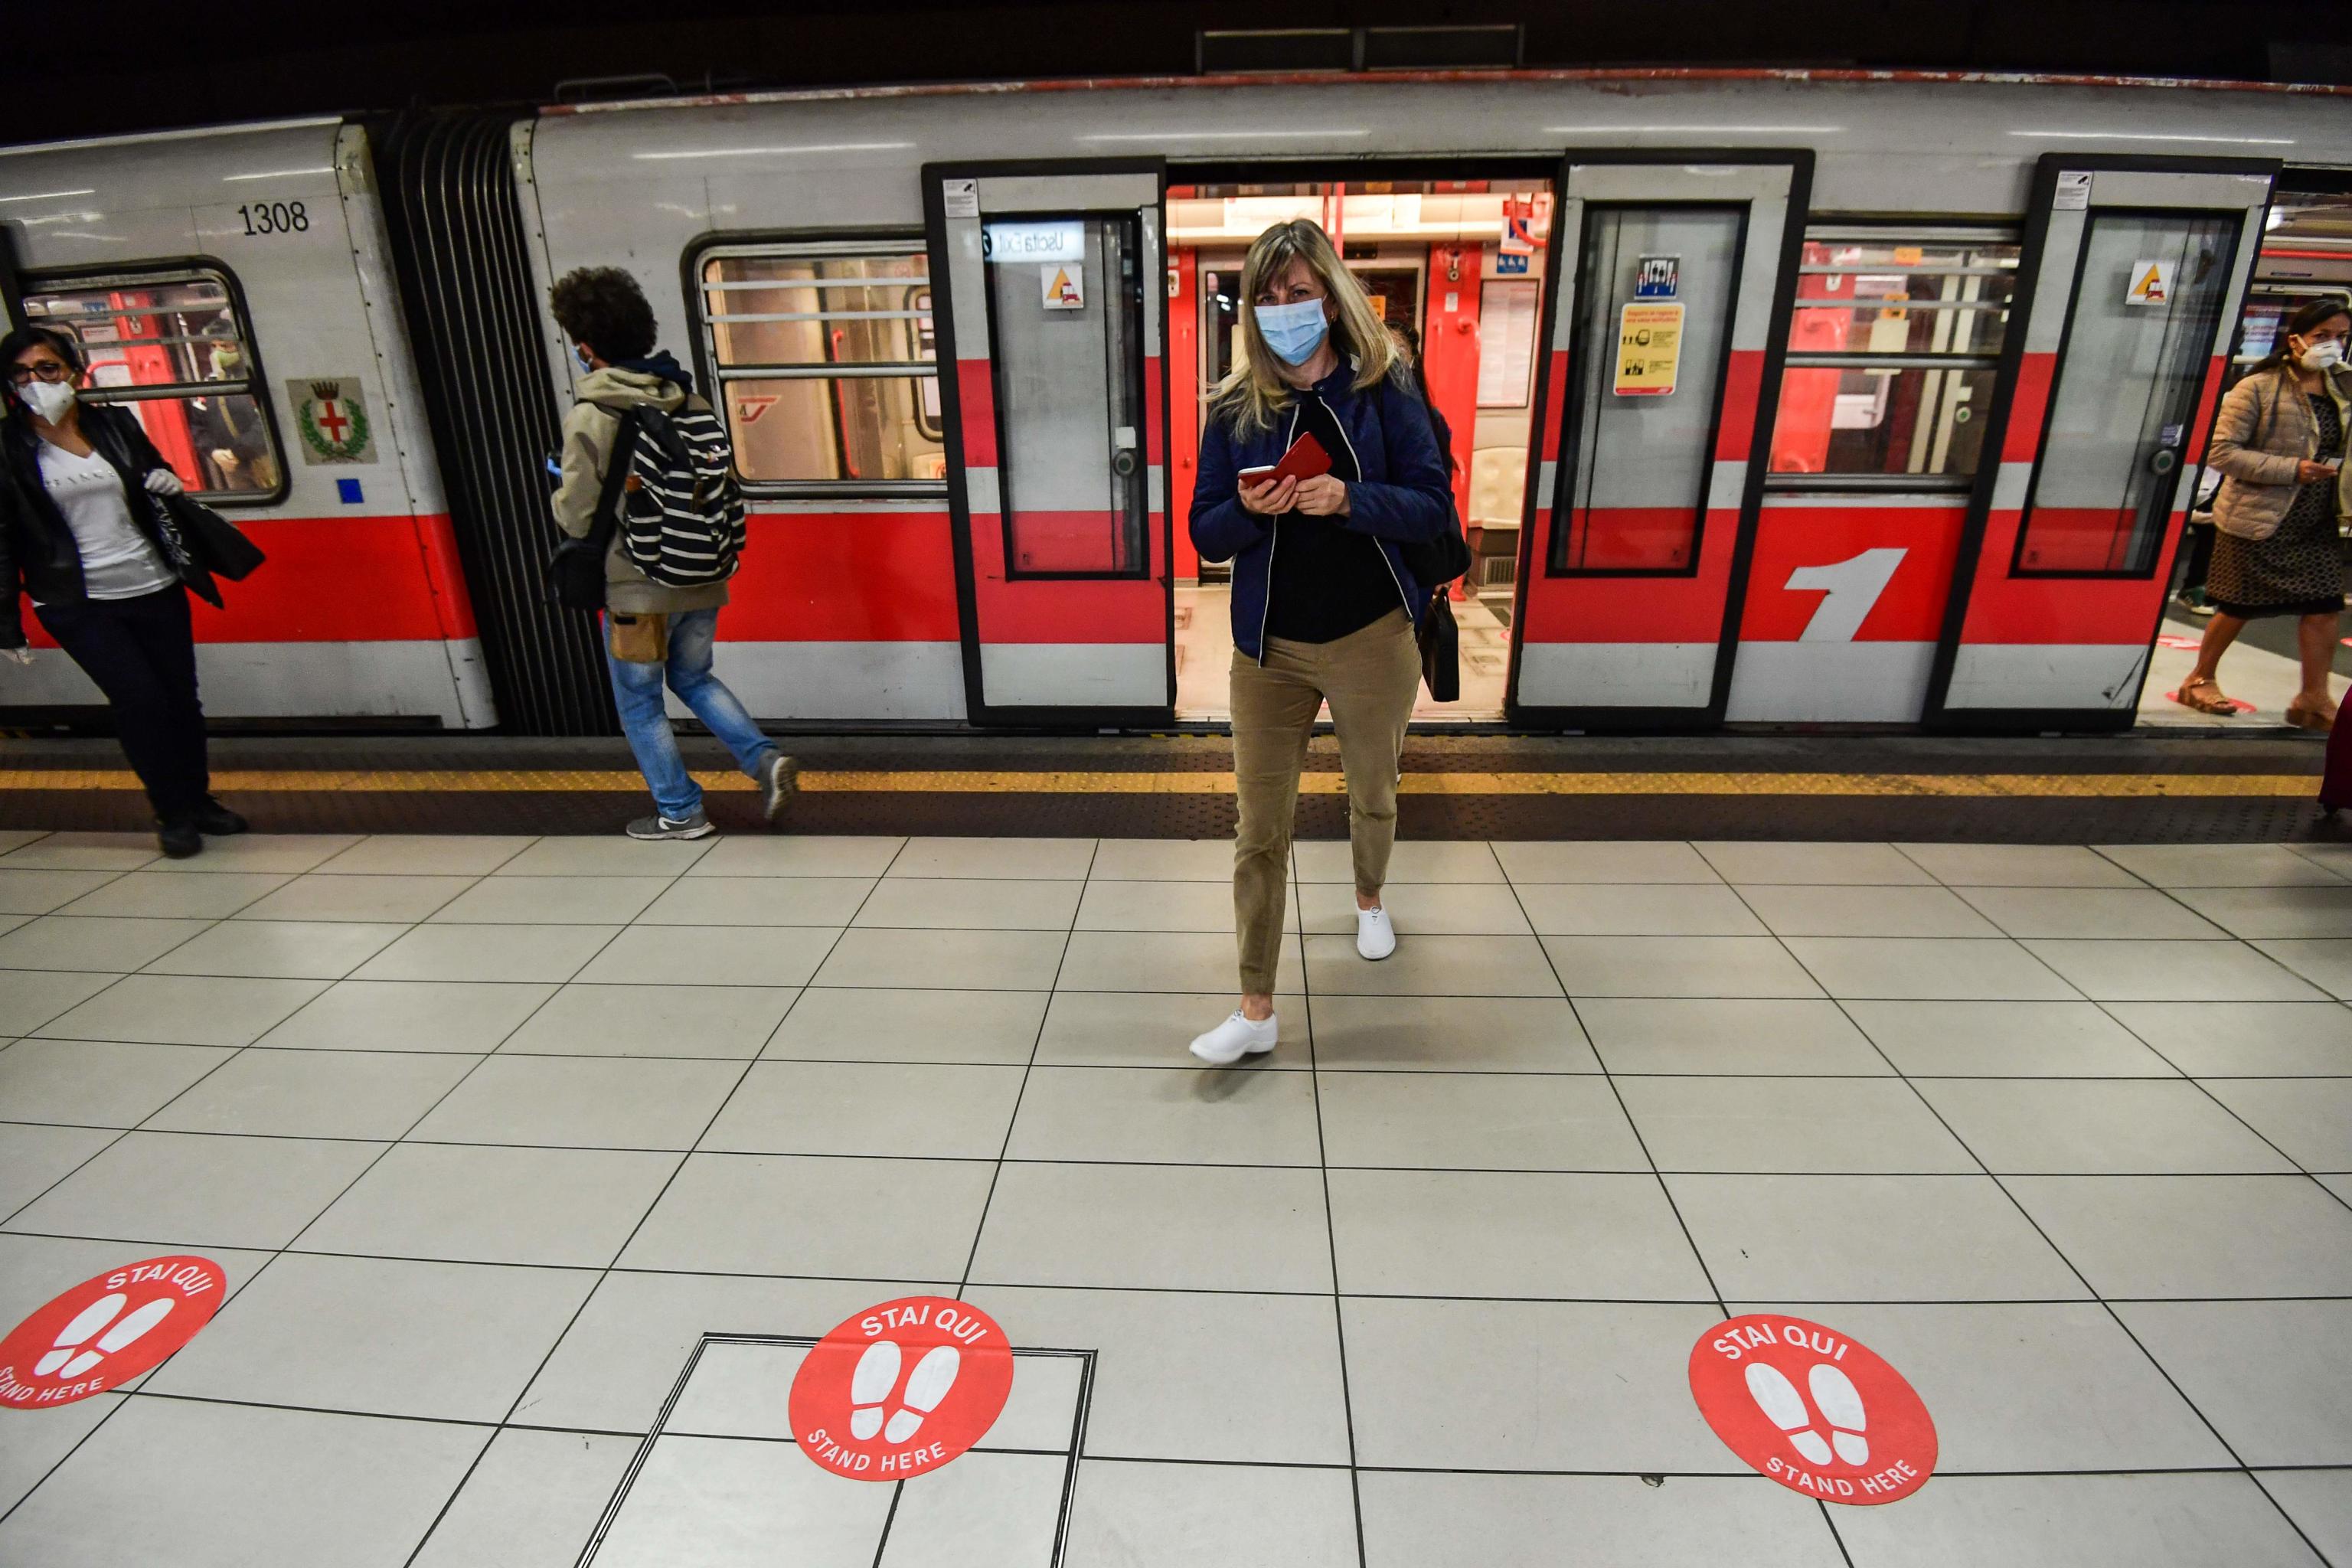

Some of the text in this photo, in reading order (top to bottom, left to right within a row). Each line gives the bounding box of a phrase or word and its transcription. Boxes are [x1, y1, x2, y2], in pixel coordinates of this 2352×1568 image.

[237, 201, 309, 236] 1308
[1783, 547, 1909, 642] 1
[106, 1263, 213, 1296] STAI QUI
[861, 1305, 988, 1345] STAI QUI
[1713, 1323, 1848, 1361] STAI QUI
[37, 1377, 103, 1401] HERE
[808, 1429, 946, 1472] STAND HERE
[1766, 1457, 1918, 1496] STAND HERE
